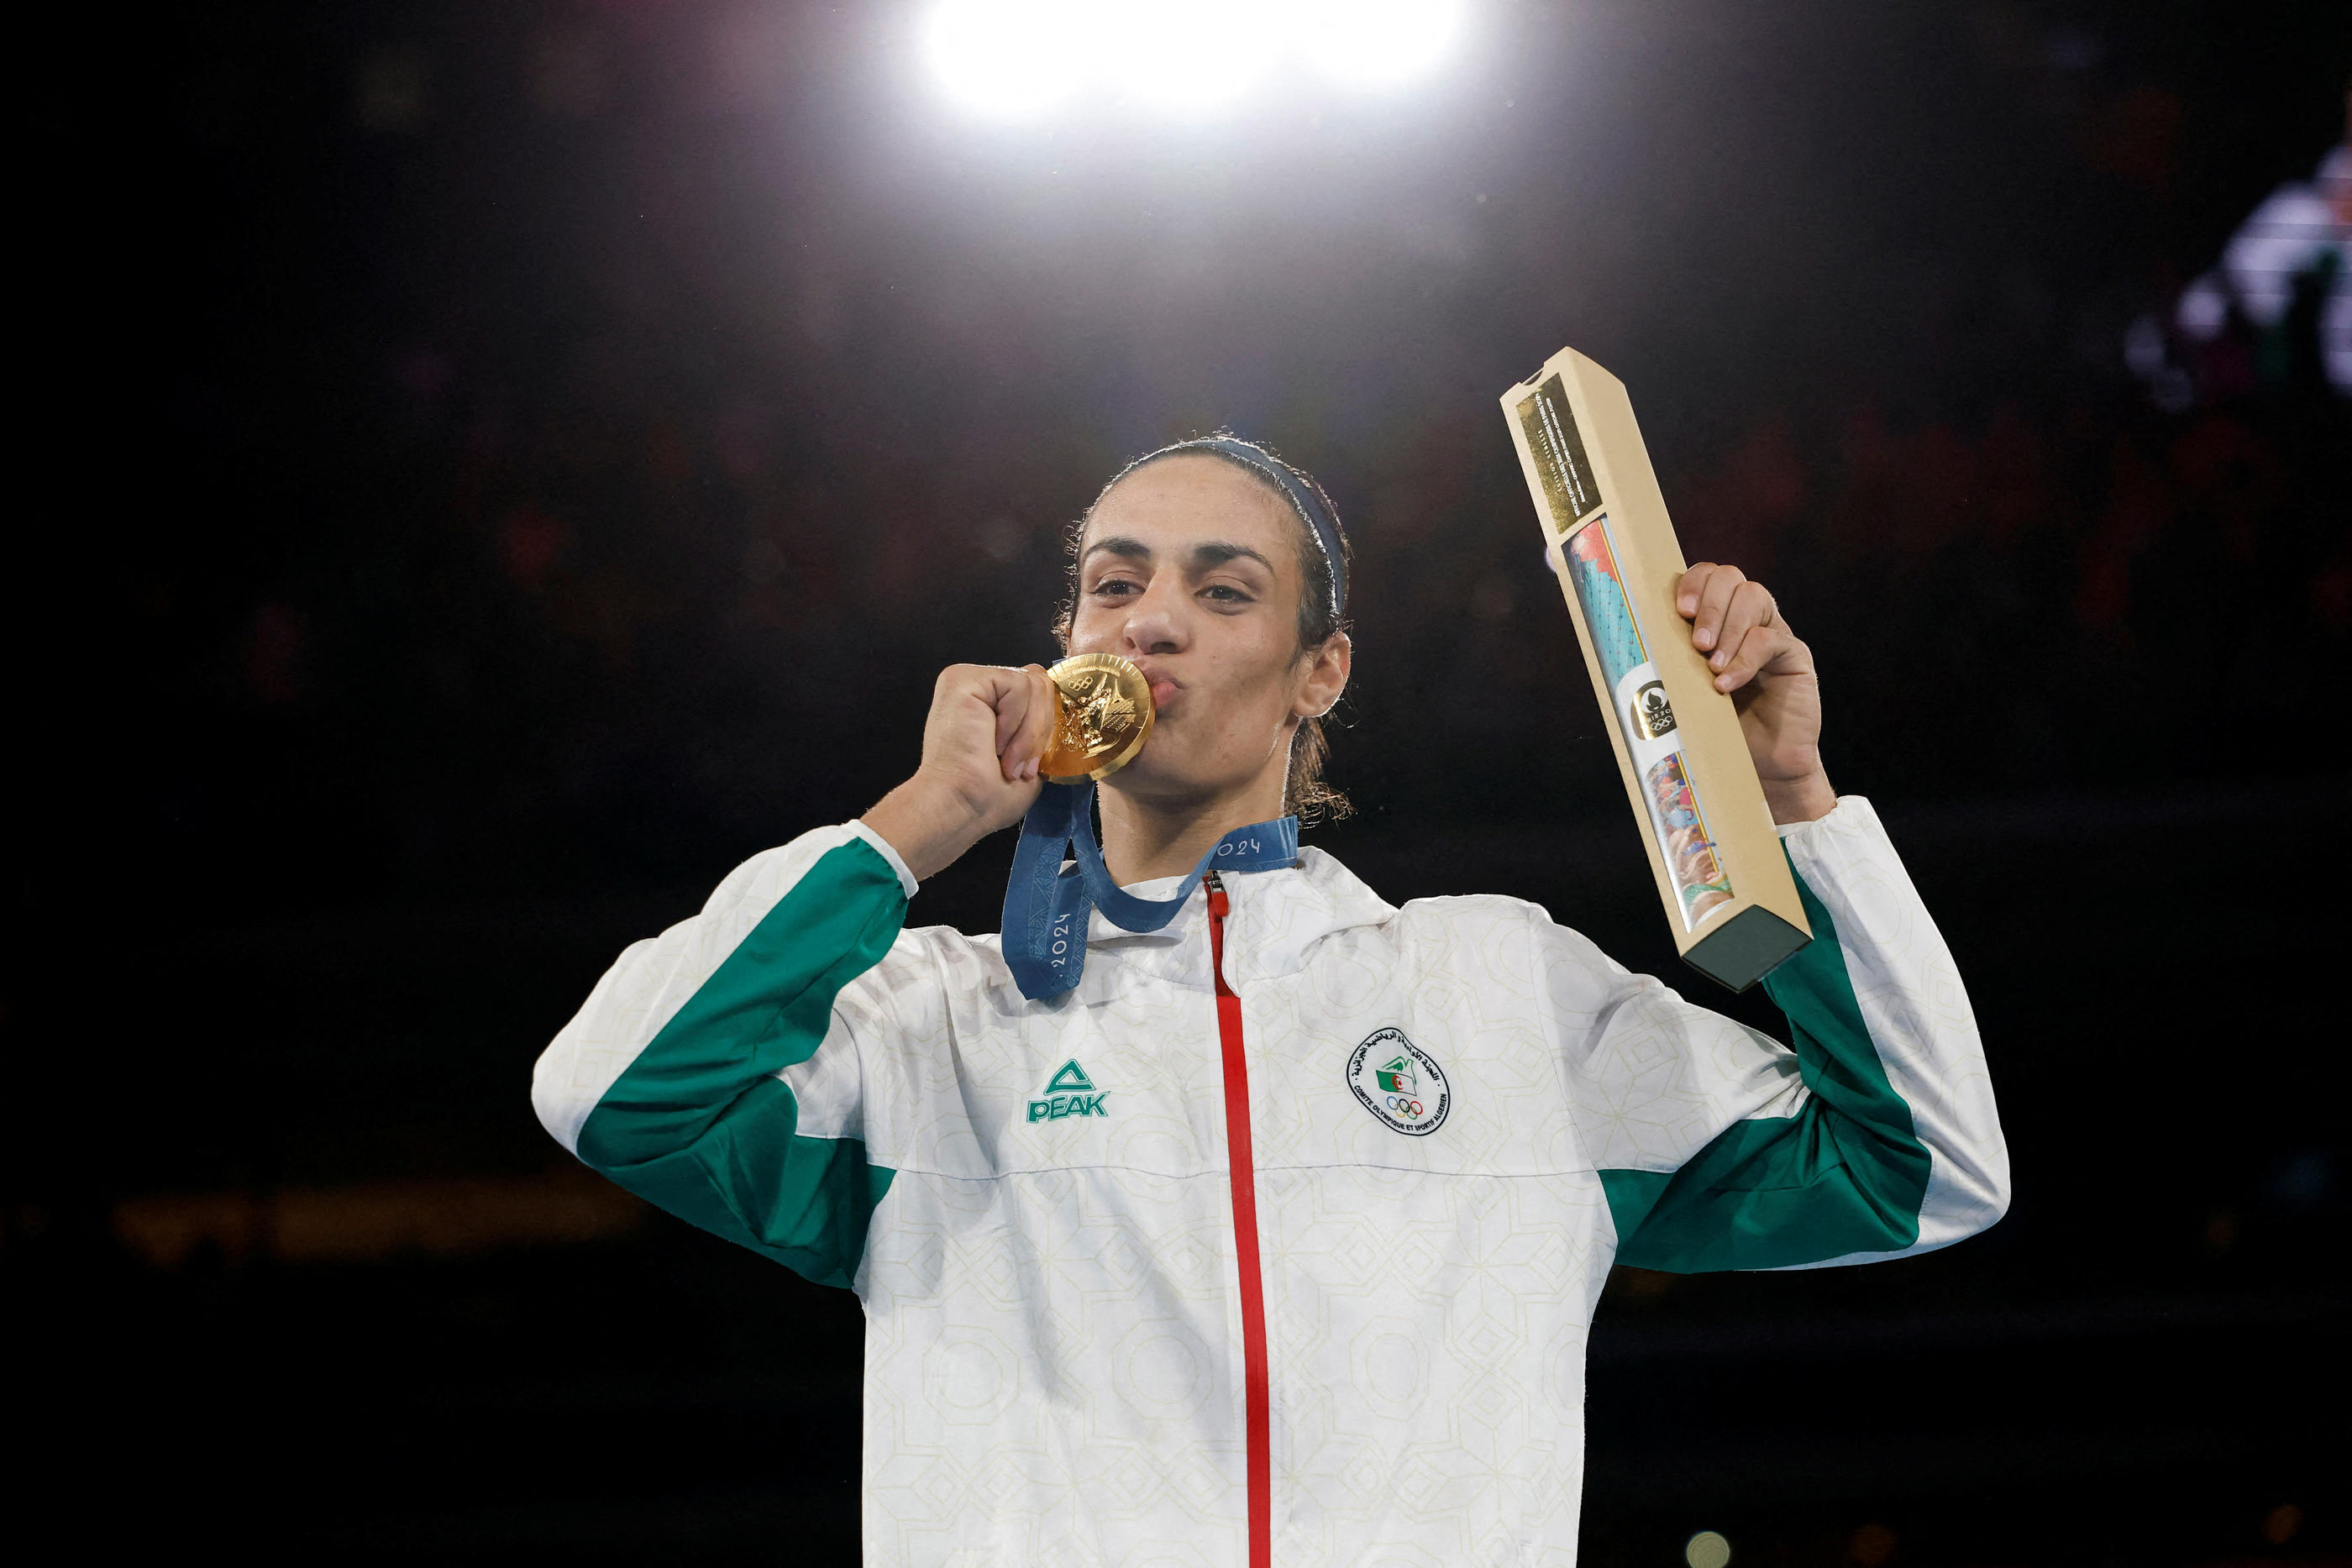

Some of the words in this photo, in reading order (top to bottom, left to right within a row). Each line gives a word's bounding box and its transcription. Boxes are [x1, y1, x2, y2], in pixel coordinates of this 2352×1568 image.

[1216, 837, 1260, 856] 024
[1051, 913, 1071, 968] 2024
[1026, 1090, 1111, 1124] PEAK
[1354, 1084, 1375, 1107] COMITE
[1373, 1104, 1405, 1130] OLYMPIQUE
[1415, 1118, 1435, 1131] SPORTIF
[1434, 1093, 1447, 1122] ALGERIEN
